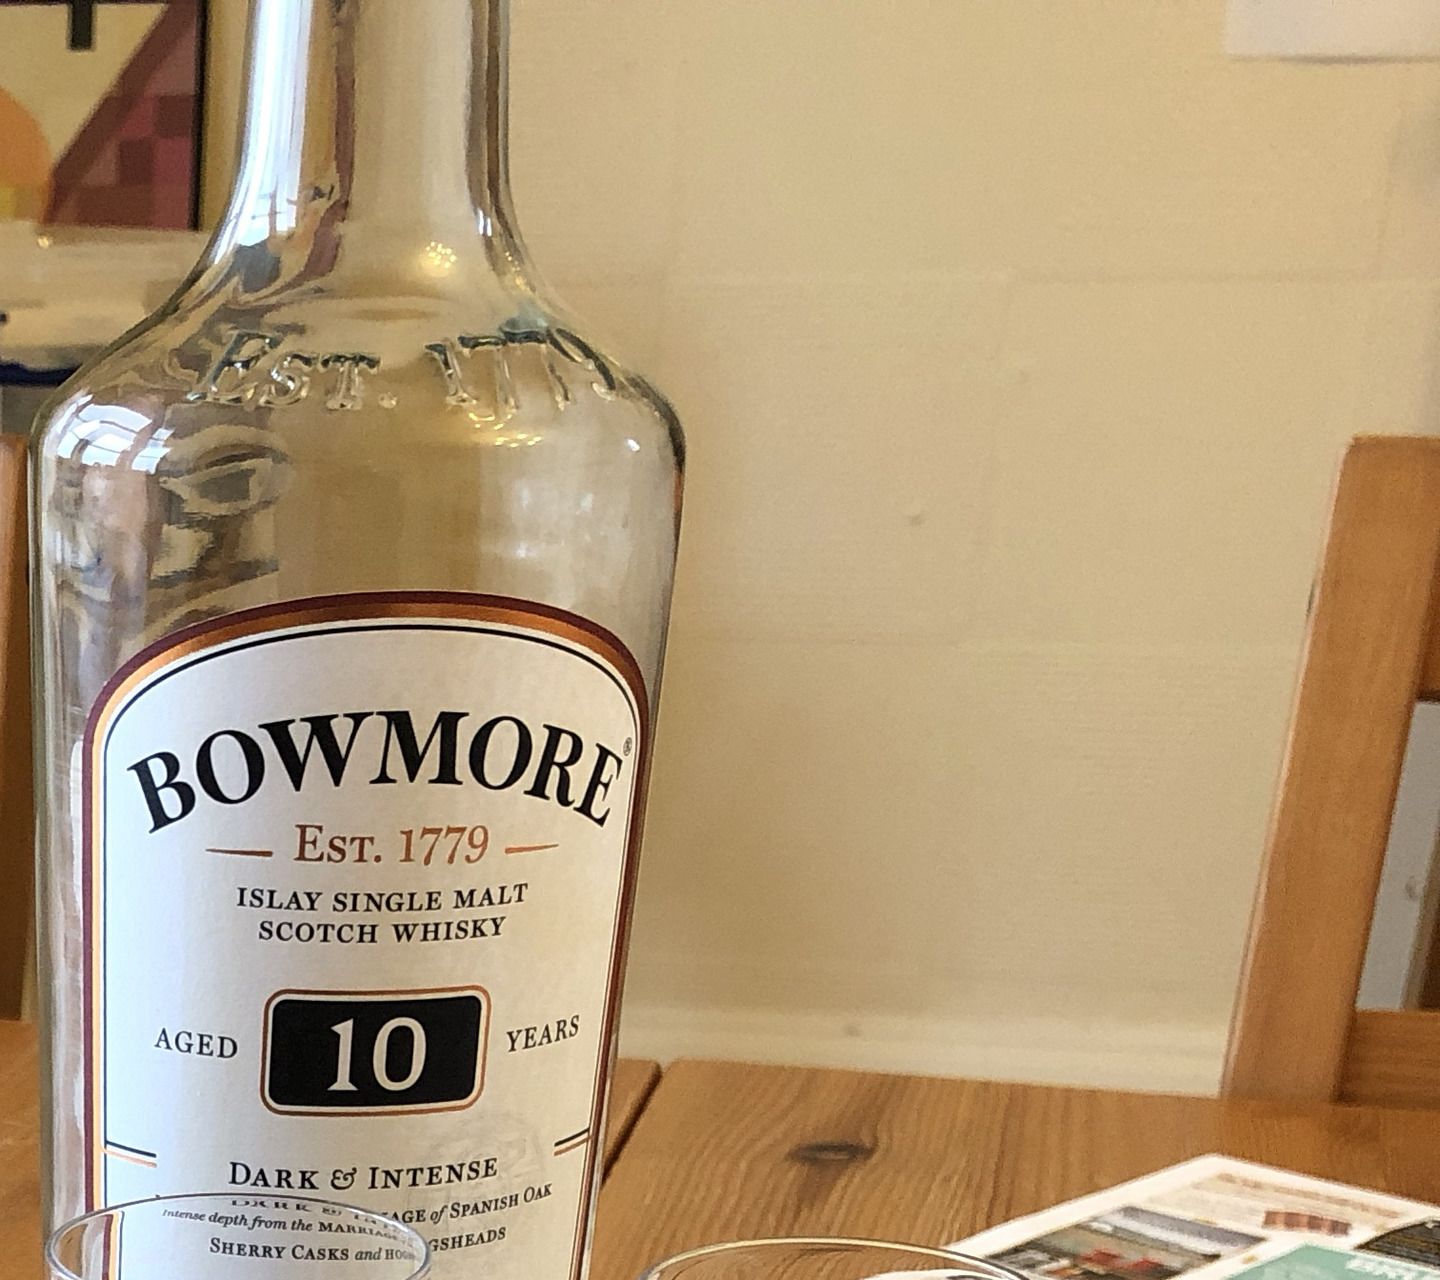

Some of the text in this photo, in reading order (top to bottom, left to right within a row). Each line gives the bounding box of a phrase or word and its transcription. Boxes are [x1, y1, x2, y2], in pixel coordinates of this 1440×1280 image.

[126, 709, 624, 834] BOWMORE
[294, 824, 491, 864] EST. 1779
[236, 882, 529, 914] ISLAY SINGLE MALT
[258, 915, 507, 944] SCOTCH WHISKY
[153, 1014, 581, 1092] AGED 10 YEARS
[228, 1157, 498, 1191] DARK & INTENSE
[162, 1209, 205, 1221] Intense
[208, 1211, 248, 1230] depth
[247, 1216, 287, 1231] from
[291, 1219, 313, 1231] the
[429, 1205, 448, 1224] of
[449, 1193, 520, 1221] SPANISH
[523, 1183, 553, 1204] OAK
[209, 1237, 287, 1259] SHERRY
[291, 1244, 349, 1261] CASKS
[354, 1248, 382, 1261] and
